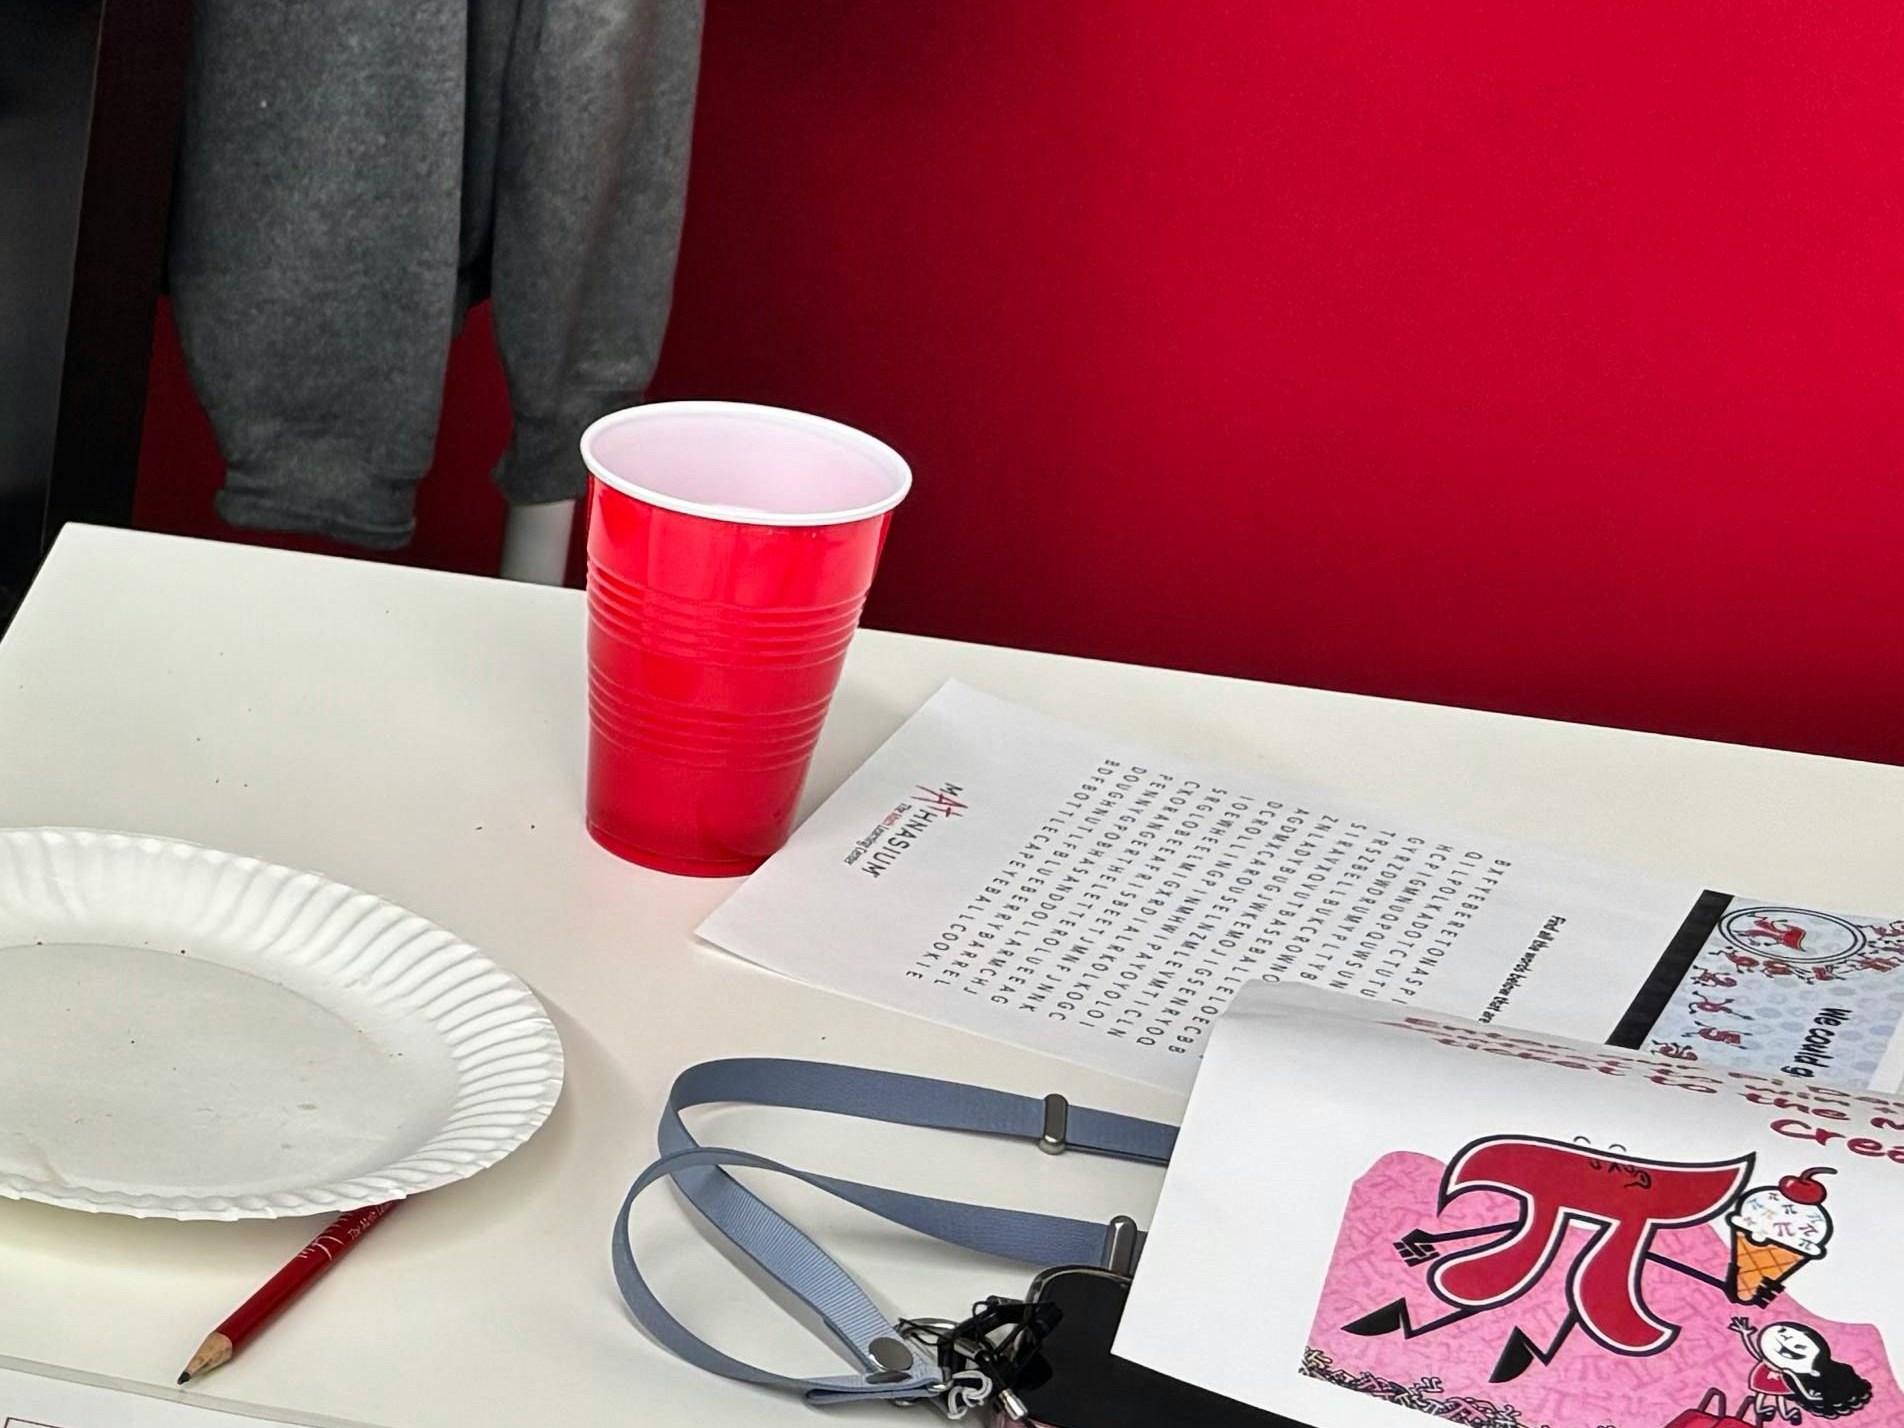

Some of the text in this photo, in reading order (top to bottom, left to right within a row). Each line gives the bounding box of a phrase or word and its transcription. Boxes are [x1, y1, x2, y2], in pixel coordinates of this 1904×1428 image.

[861, 782, 968, 878] MATHNASIUM
[1794, 1005, 1854, 1069] We could
